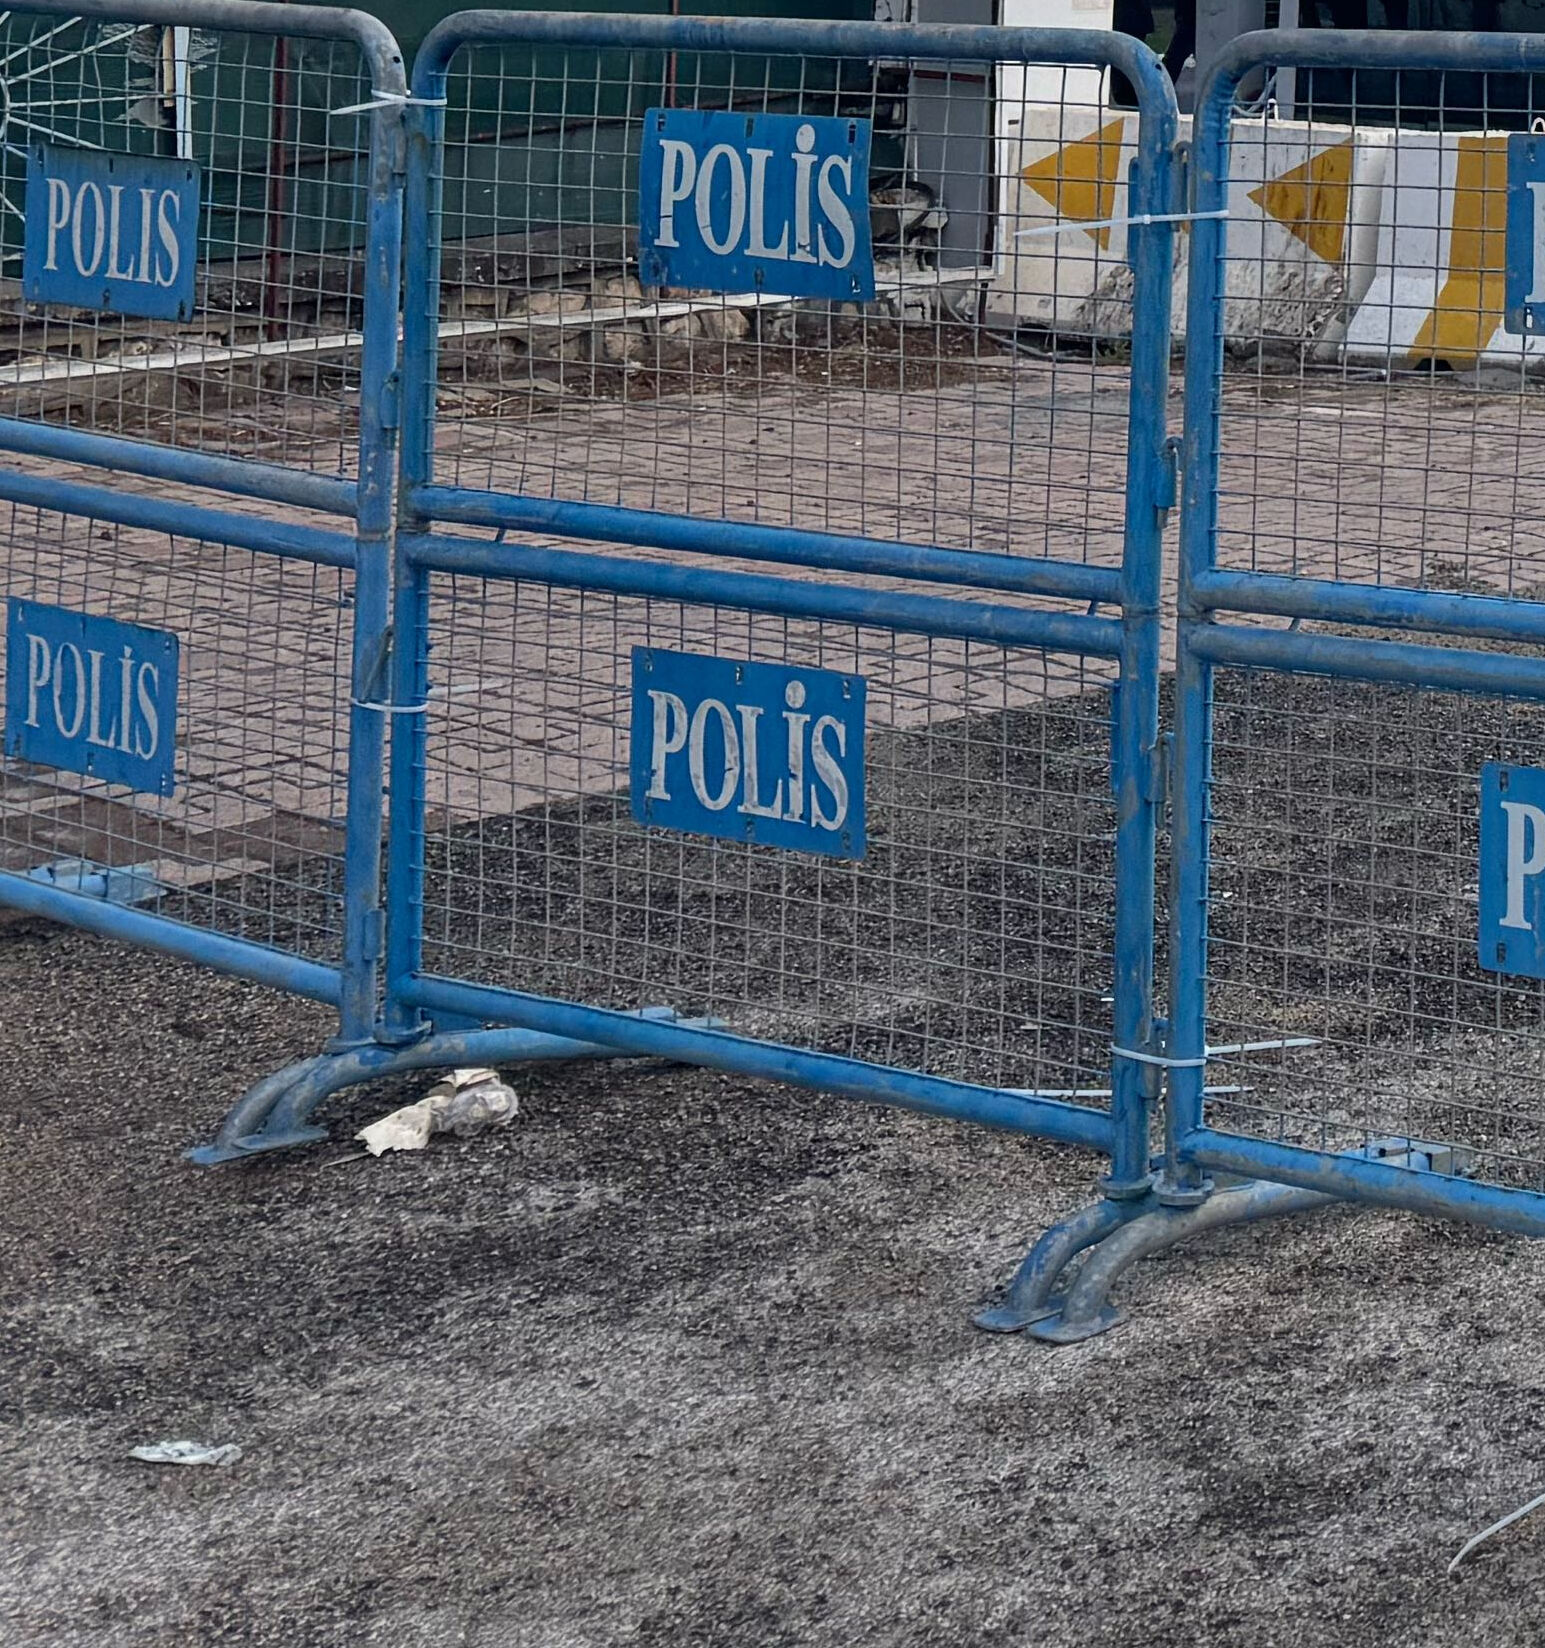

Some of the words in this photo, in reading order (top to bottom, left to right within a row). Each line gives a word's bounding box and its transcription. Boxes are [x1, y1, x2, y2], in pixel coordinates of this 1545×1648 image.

[655, 123, 855, 269] POLİS
[25, 634, 160, 760] POLİS
[645, 679, 848, 832] POLİS
